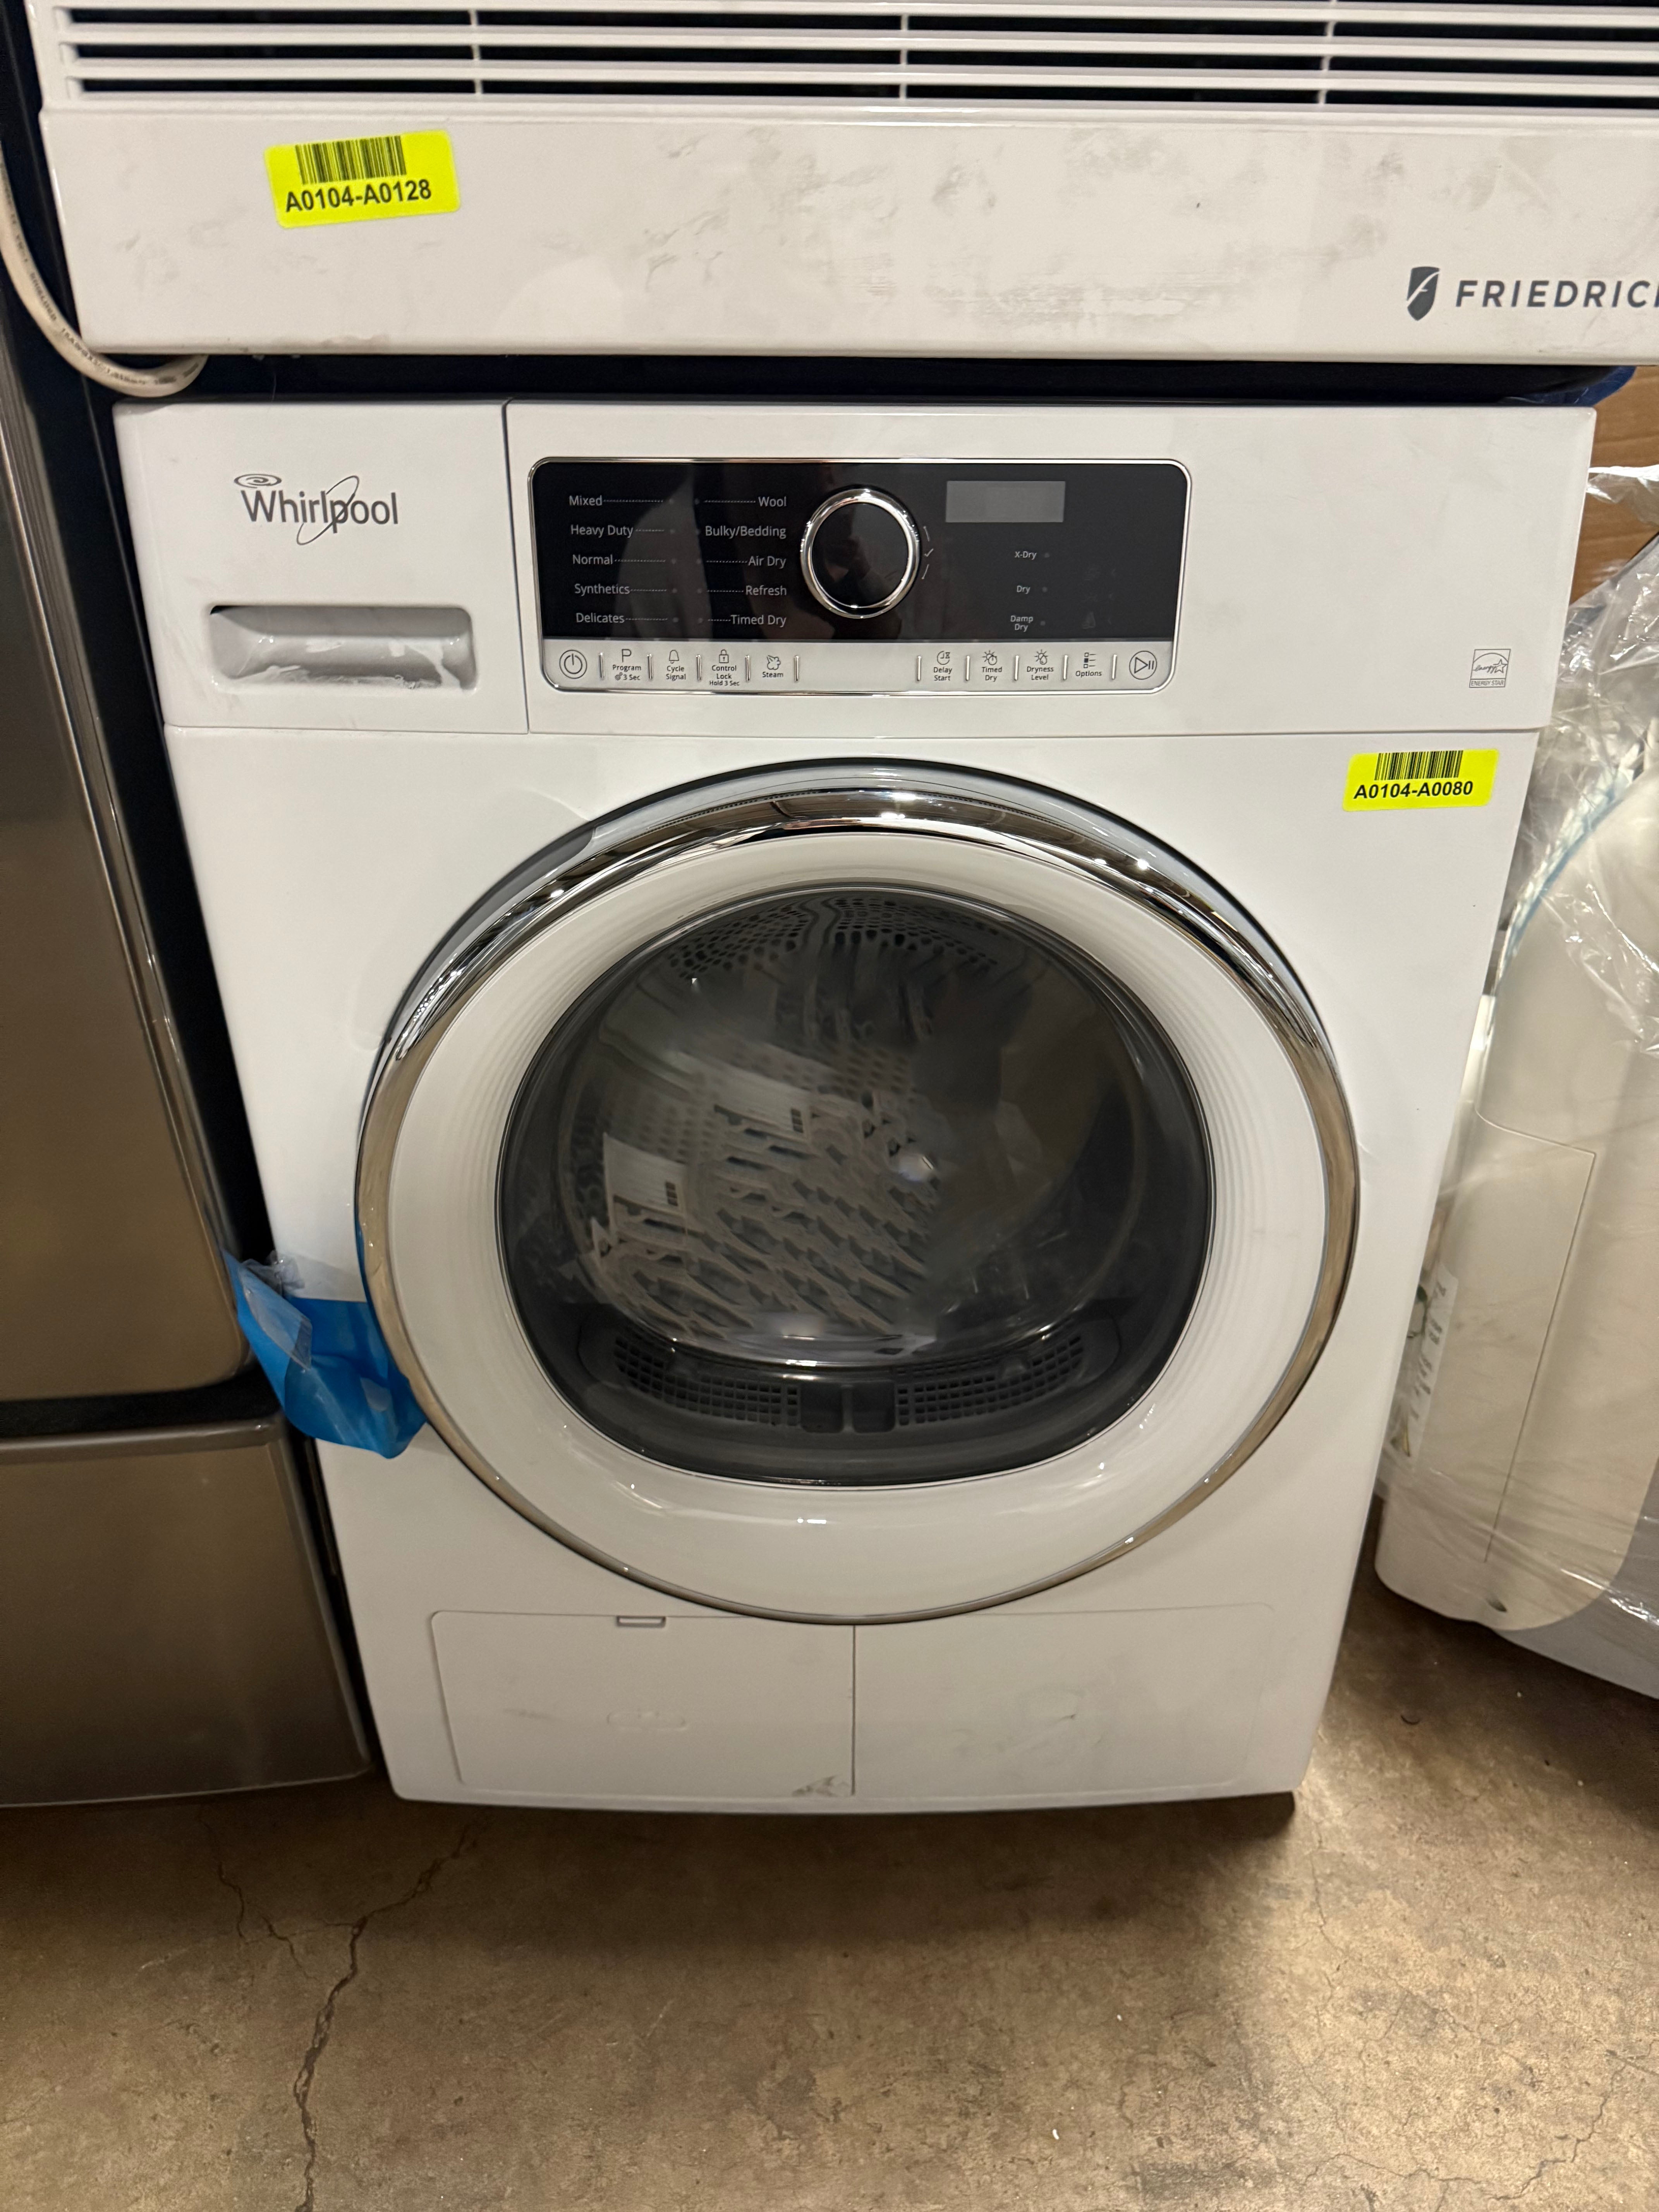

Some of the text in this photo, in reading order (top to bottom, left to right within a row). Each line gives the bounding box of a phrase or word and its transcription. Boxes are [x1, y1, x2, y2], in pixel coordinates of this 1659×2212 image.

[286, 179, 431, 213] A0104-A0128
[1455, 280, 1659, 308] FRIEDRIC
[569, 495, 603, 506] Mixed
[758, 496, 786, 507] Wool
[240, 489, 398, 534] Whirlpool
[571, 524, 634, 538] Heavy Duty
[705, 525, 786, 539] Bulky/Bedding
[572, 554, 613, 565] Normal
[1014, 551, 1037, 560] X-Dry
[748, 556, 786, 569] Air Dry
[574, 583, 630, 596] Synthetics
[746, 585, 787, 596] Refresh
[1017, 585, 1030, 594] Dry
[576, 612, 625, 623] Delicates
[731, 615, 787, 628] Timed Dry
[1010, 615, 1034, 623] Damp
[1014, 623, 1029, 632] Dry
[1353, 780, 1473, 799] A0104-A0080
